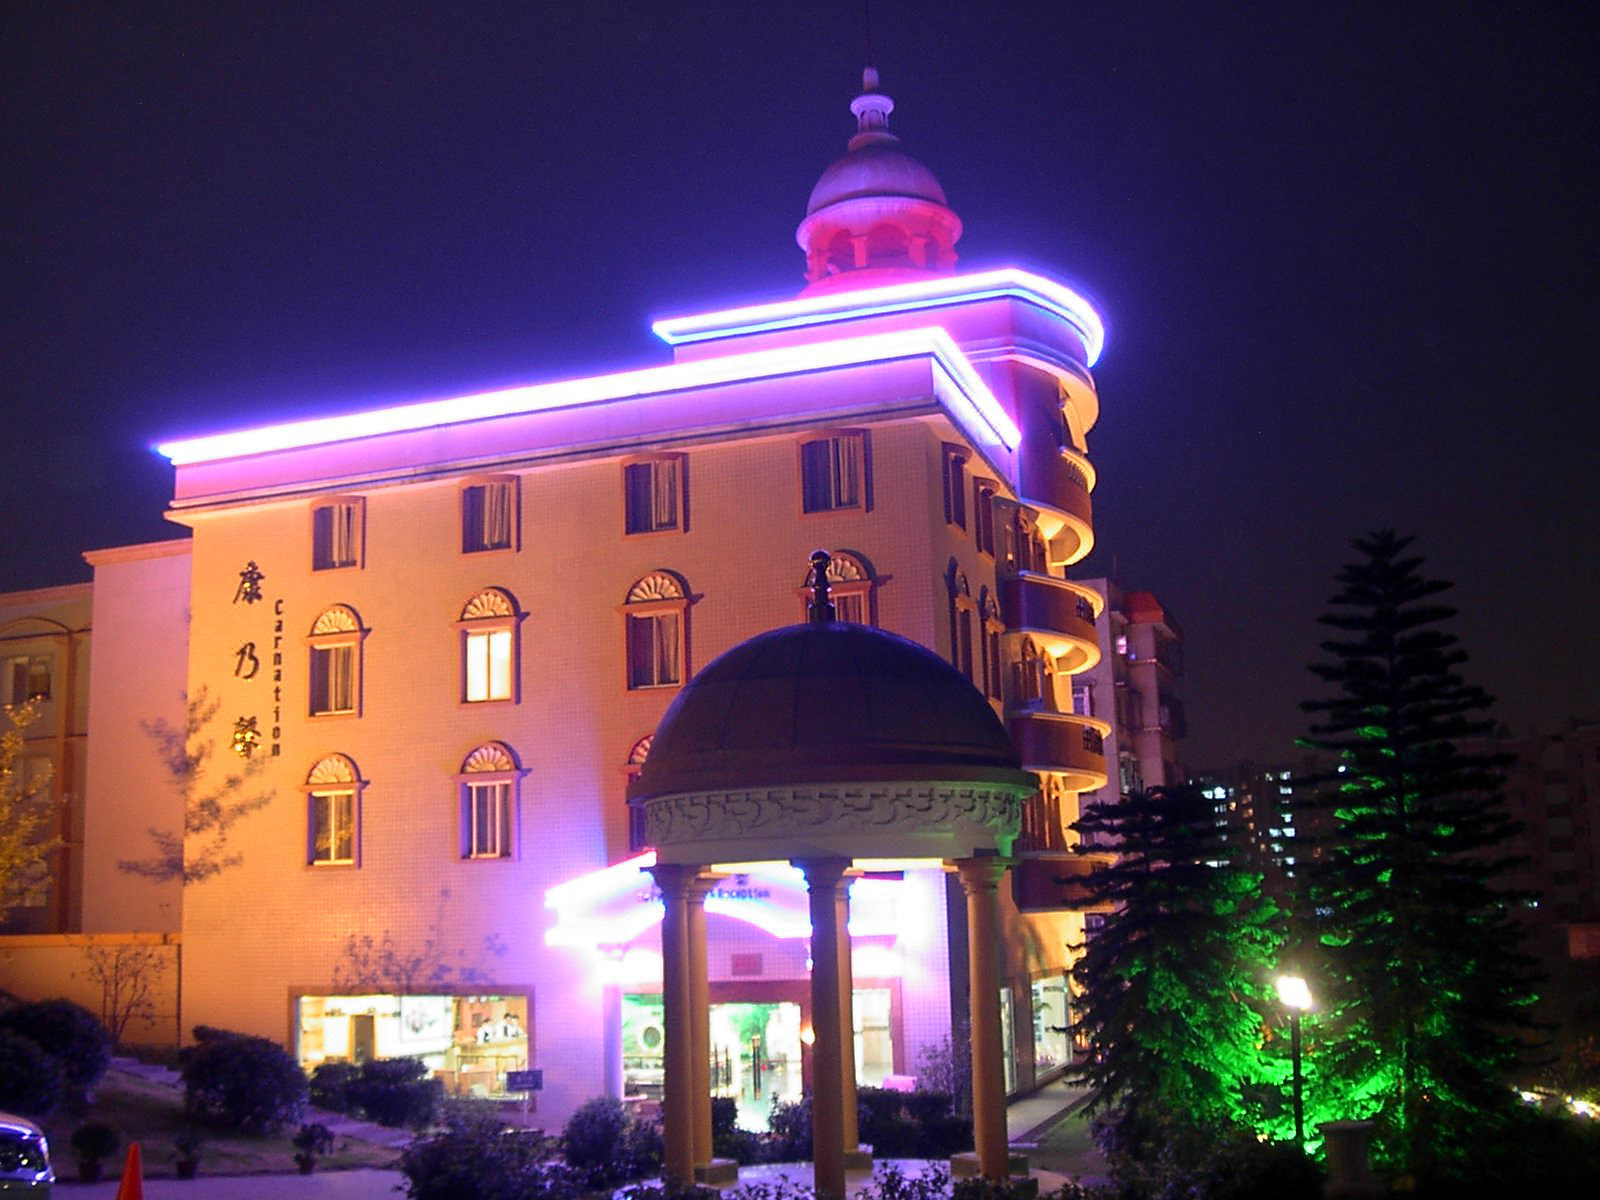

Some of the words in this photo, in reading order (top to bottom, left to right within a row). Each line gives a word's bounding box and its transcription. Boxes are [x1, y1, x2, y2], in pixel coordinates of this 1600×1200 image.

[230, 560, 265, 759] 康乃馨
[271, 599, 283, 756] Carnation
